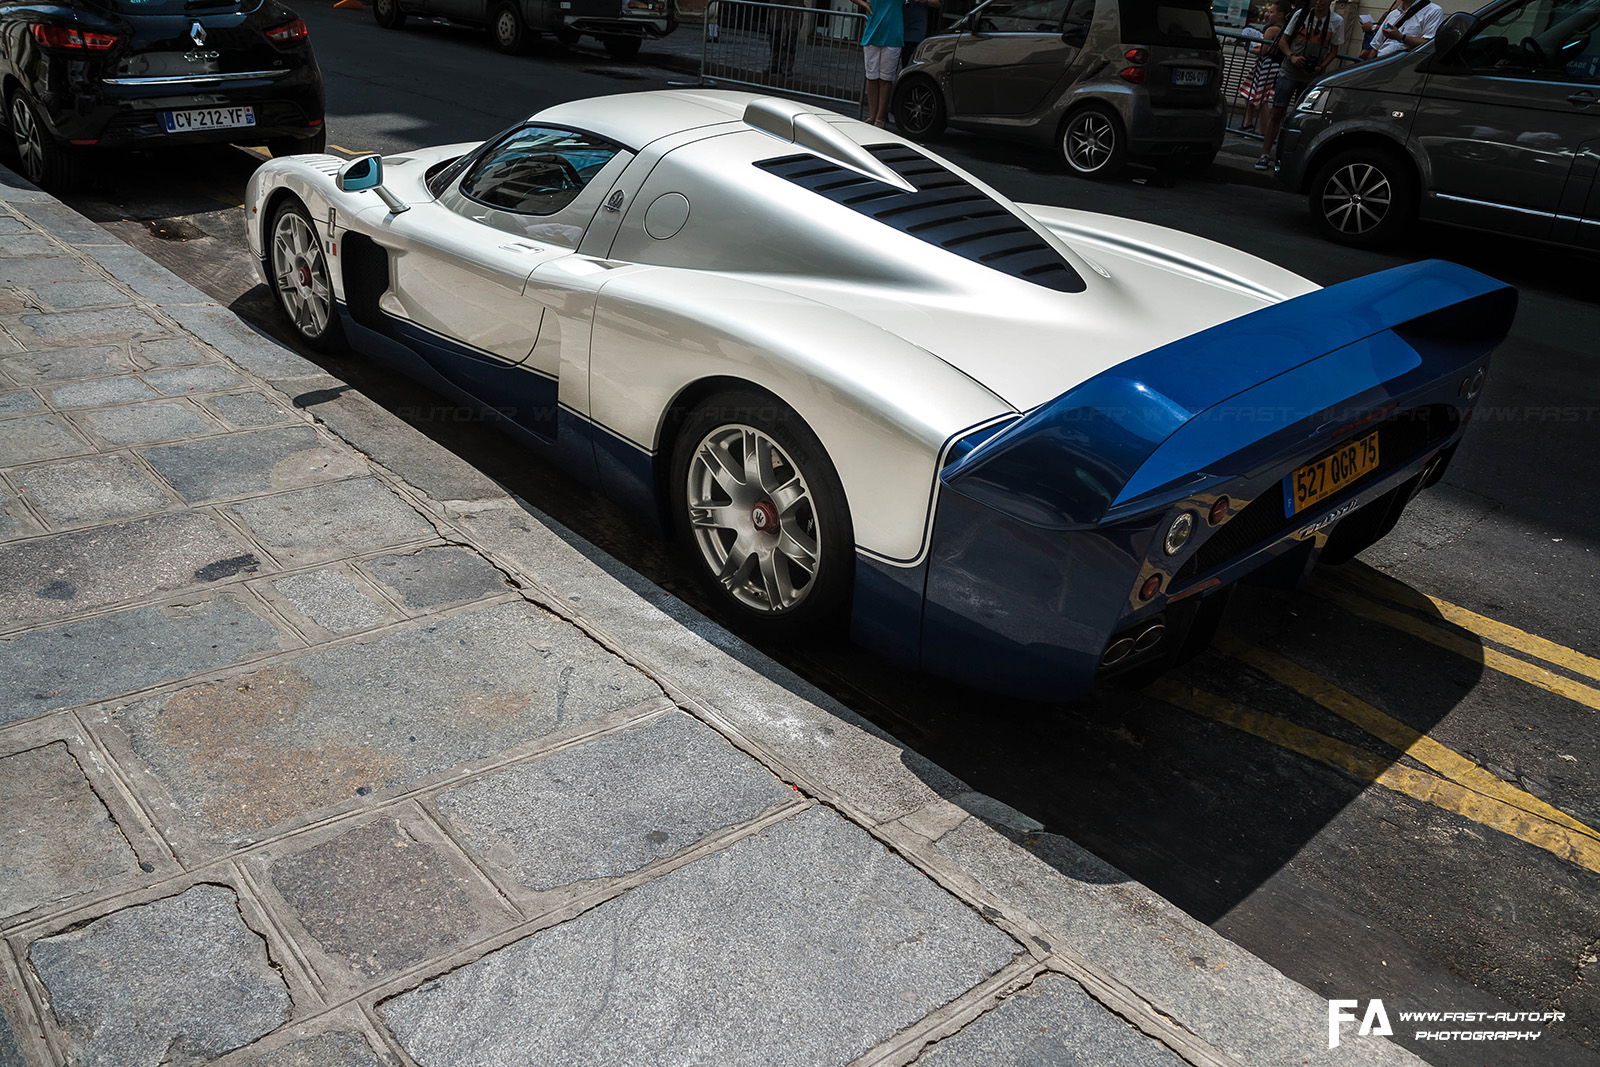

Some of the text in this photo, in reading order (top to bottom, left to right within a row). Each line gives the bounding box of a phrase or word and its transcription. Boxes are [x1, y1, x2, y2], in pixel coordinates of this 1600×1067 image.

[175, 108, 242, 128] CV-212-YF
[1297, 461, 1326, 503] 527
[1331, 446, 1357, 485] QGR
[1360, 434, 1376, 468] 75
